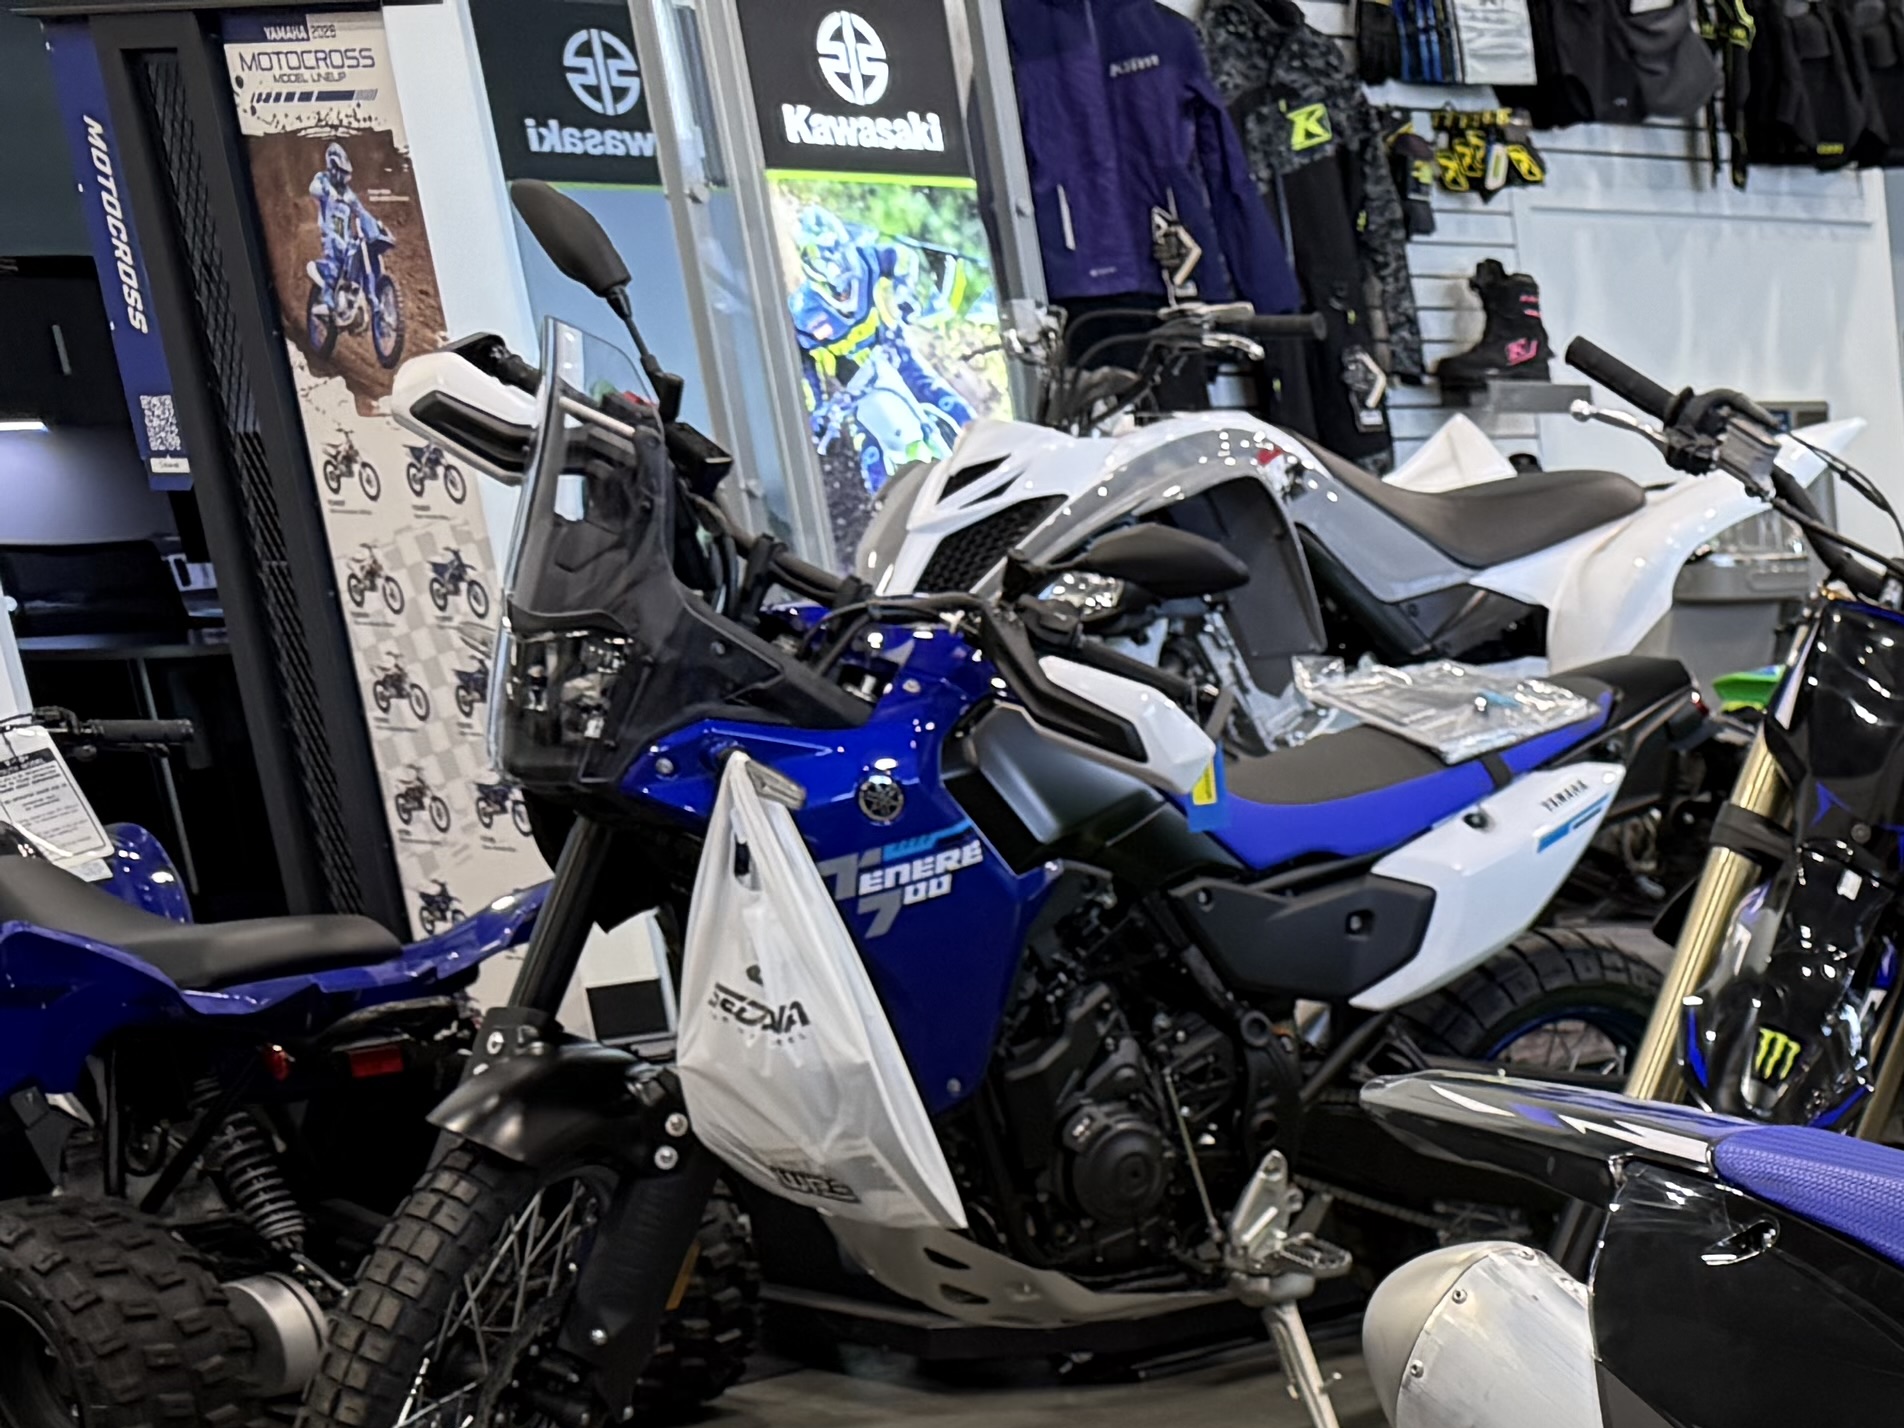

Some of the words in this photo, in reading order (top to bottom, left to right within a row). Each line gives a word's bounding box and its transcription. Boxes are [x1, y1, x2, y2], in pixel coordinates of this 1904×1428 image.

[263, 24, 309, 41] YAMAHA
[239, 48, 376, 72] MOTOCROSS
[273, 73, 307, 84] MODEL
[310, 71, 347, 83] LINEUP
[781, 104, 945, 152] Kawasaki
[83, 114, 149, 335] MOTOCROSS
